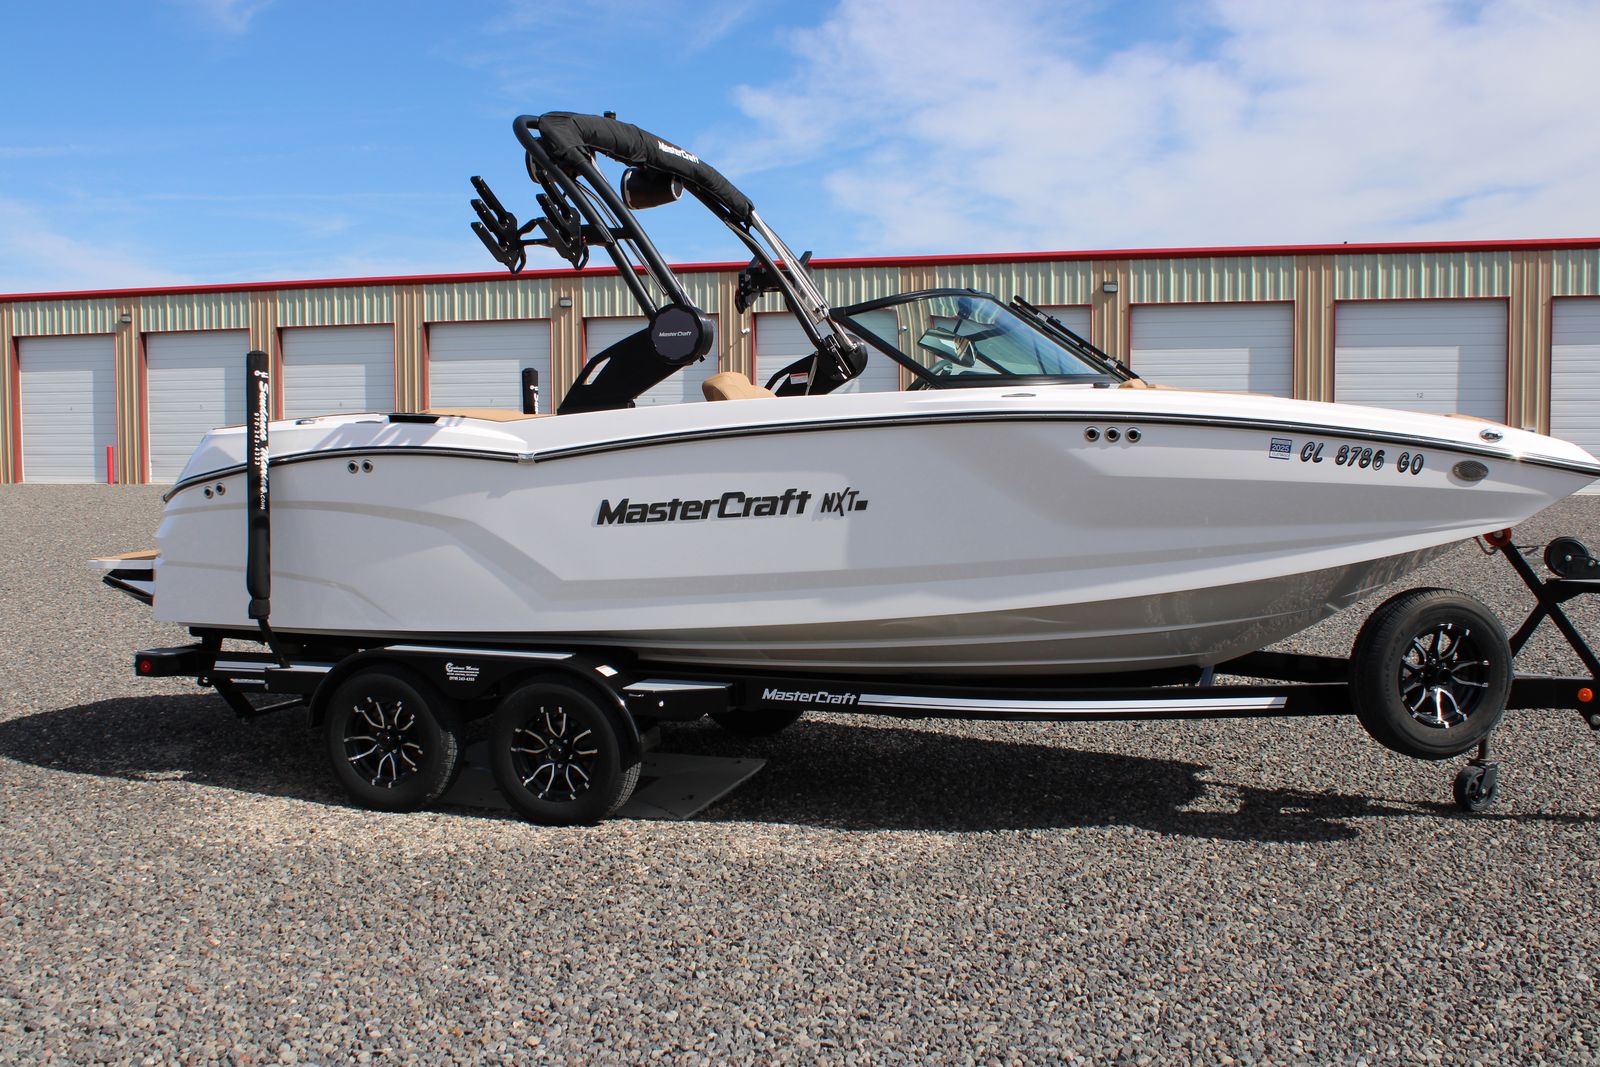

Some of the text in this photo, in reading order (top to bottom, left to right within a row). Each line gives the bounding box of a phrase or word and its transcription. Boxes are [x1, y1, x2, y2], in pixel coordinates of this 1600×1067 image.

[657, 140, 699, 164] MasterCraft
[1271, 444, 1291, 453] 2025
[1300, 441, 1325, 463] CL
[1335, 444, 1386, 472] 8786
[596, 487, 860, 526] MasterCraft NXT
[761, 687, 857, 705] MasterCraft
